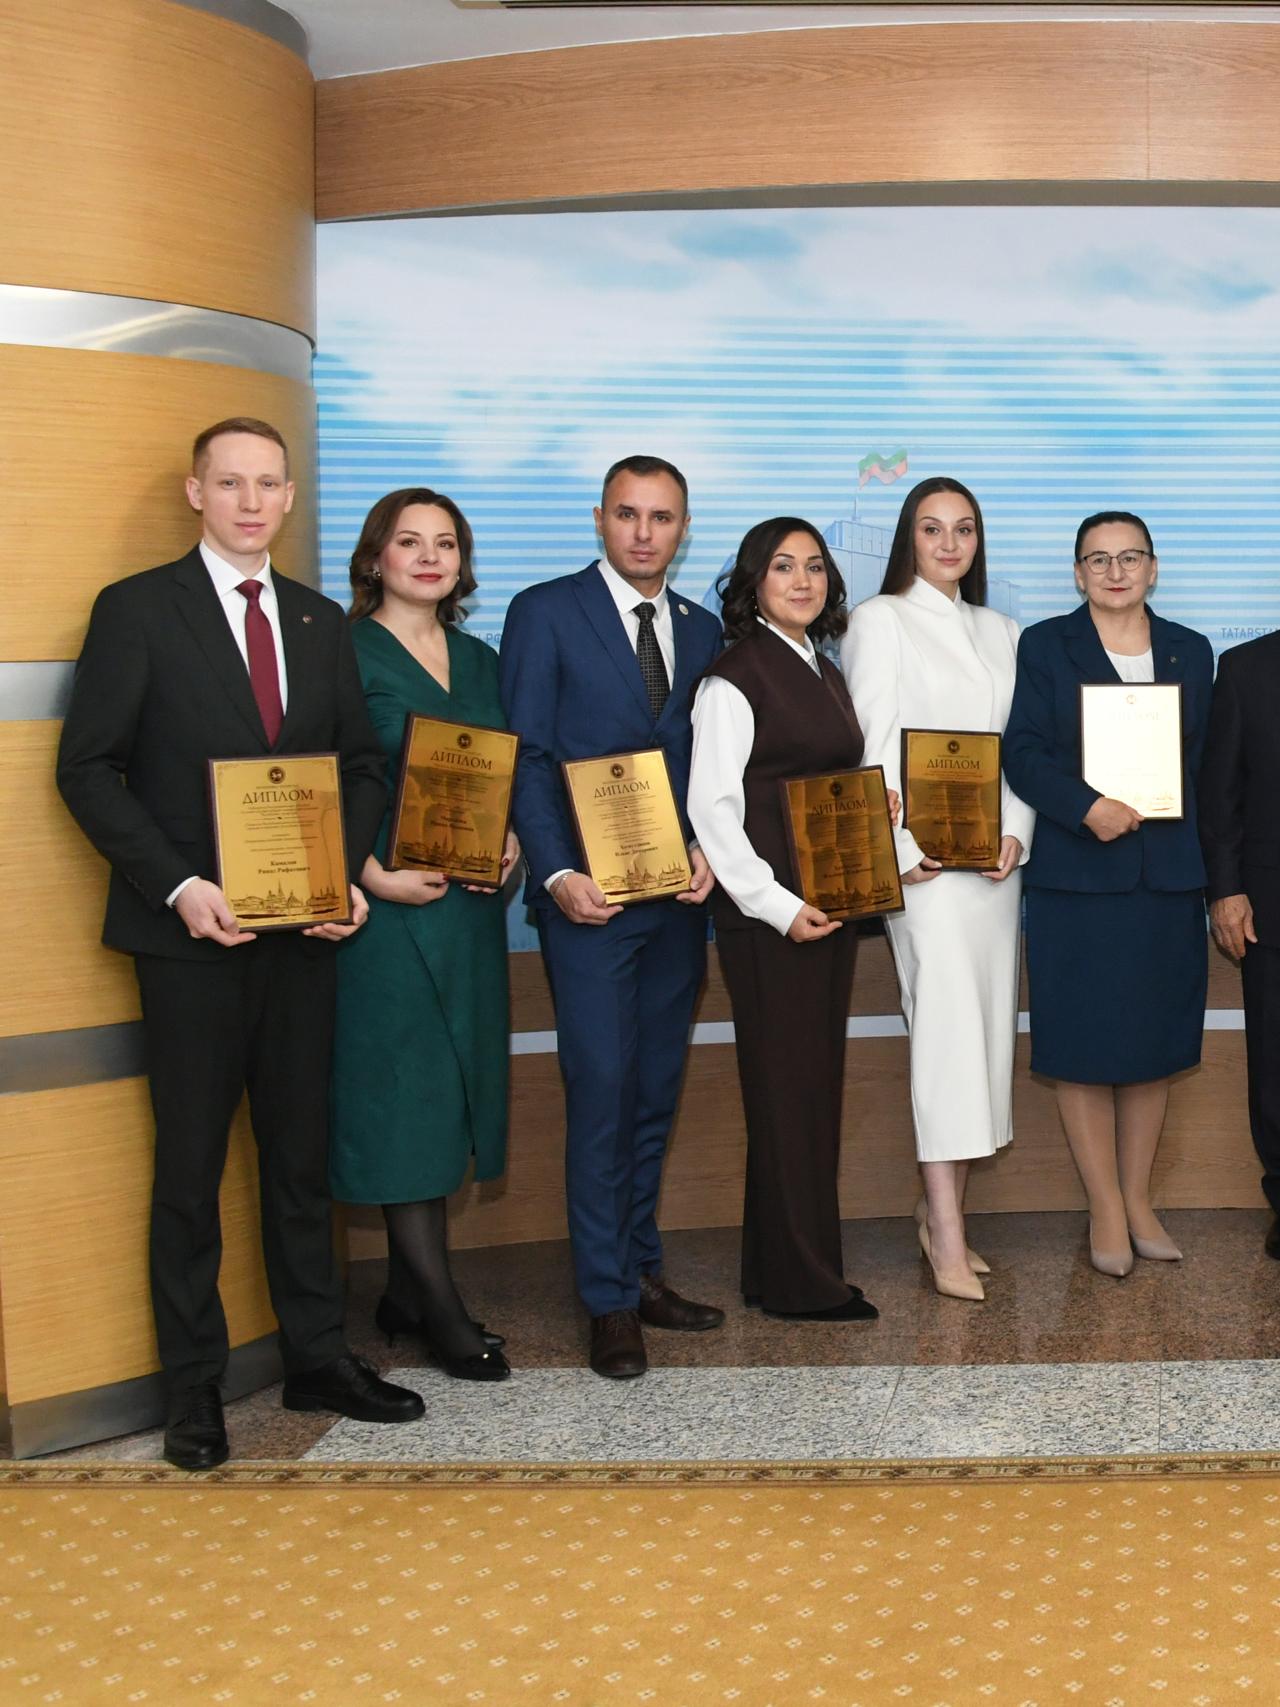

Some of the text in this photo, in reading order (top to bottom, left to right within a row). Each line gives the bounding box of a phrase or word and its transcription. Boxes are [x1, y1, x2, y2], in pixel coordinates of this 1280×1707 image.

[430, 750, 492, 770] ДИПЛОМ
[926, 759, 980, 770] ДИПЛОМ
[242, 789, 313, 804] ДИПЛОМ
[594, 781, 650, 799] ДИПЛОМ
[811, 799, 866, 816] ДИПЛОМ
